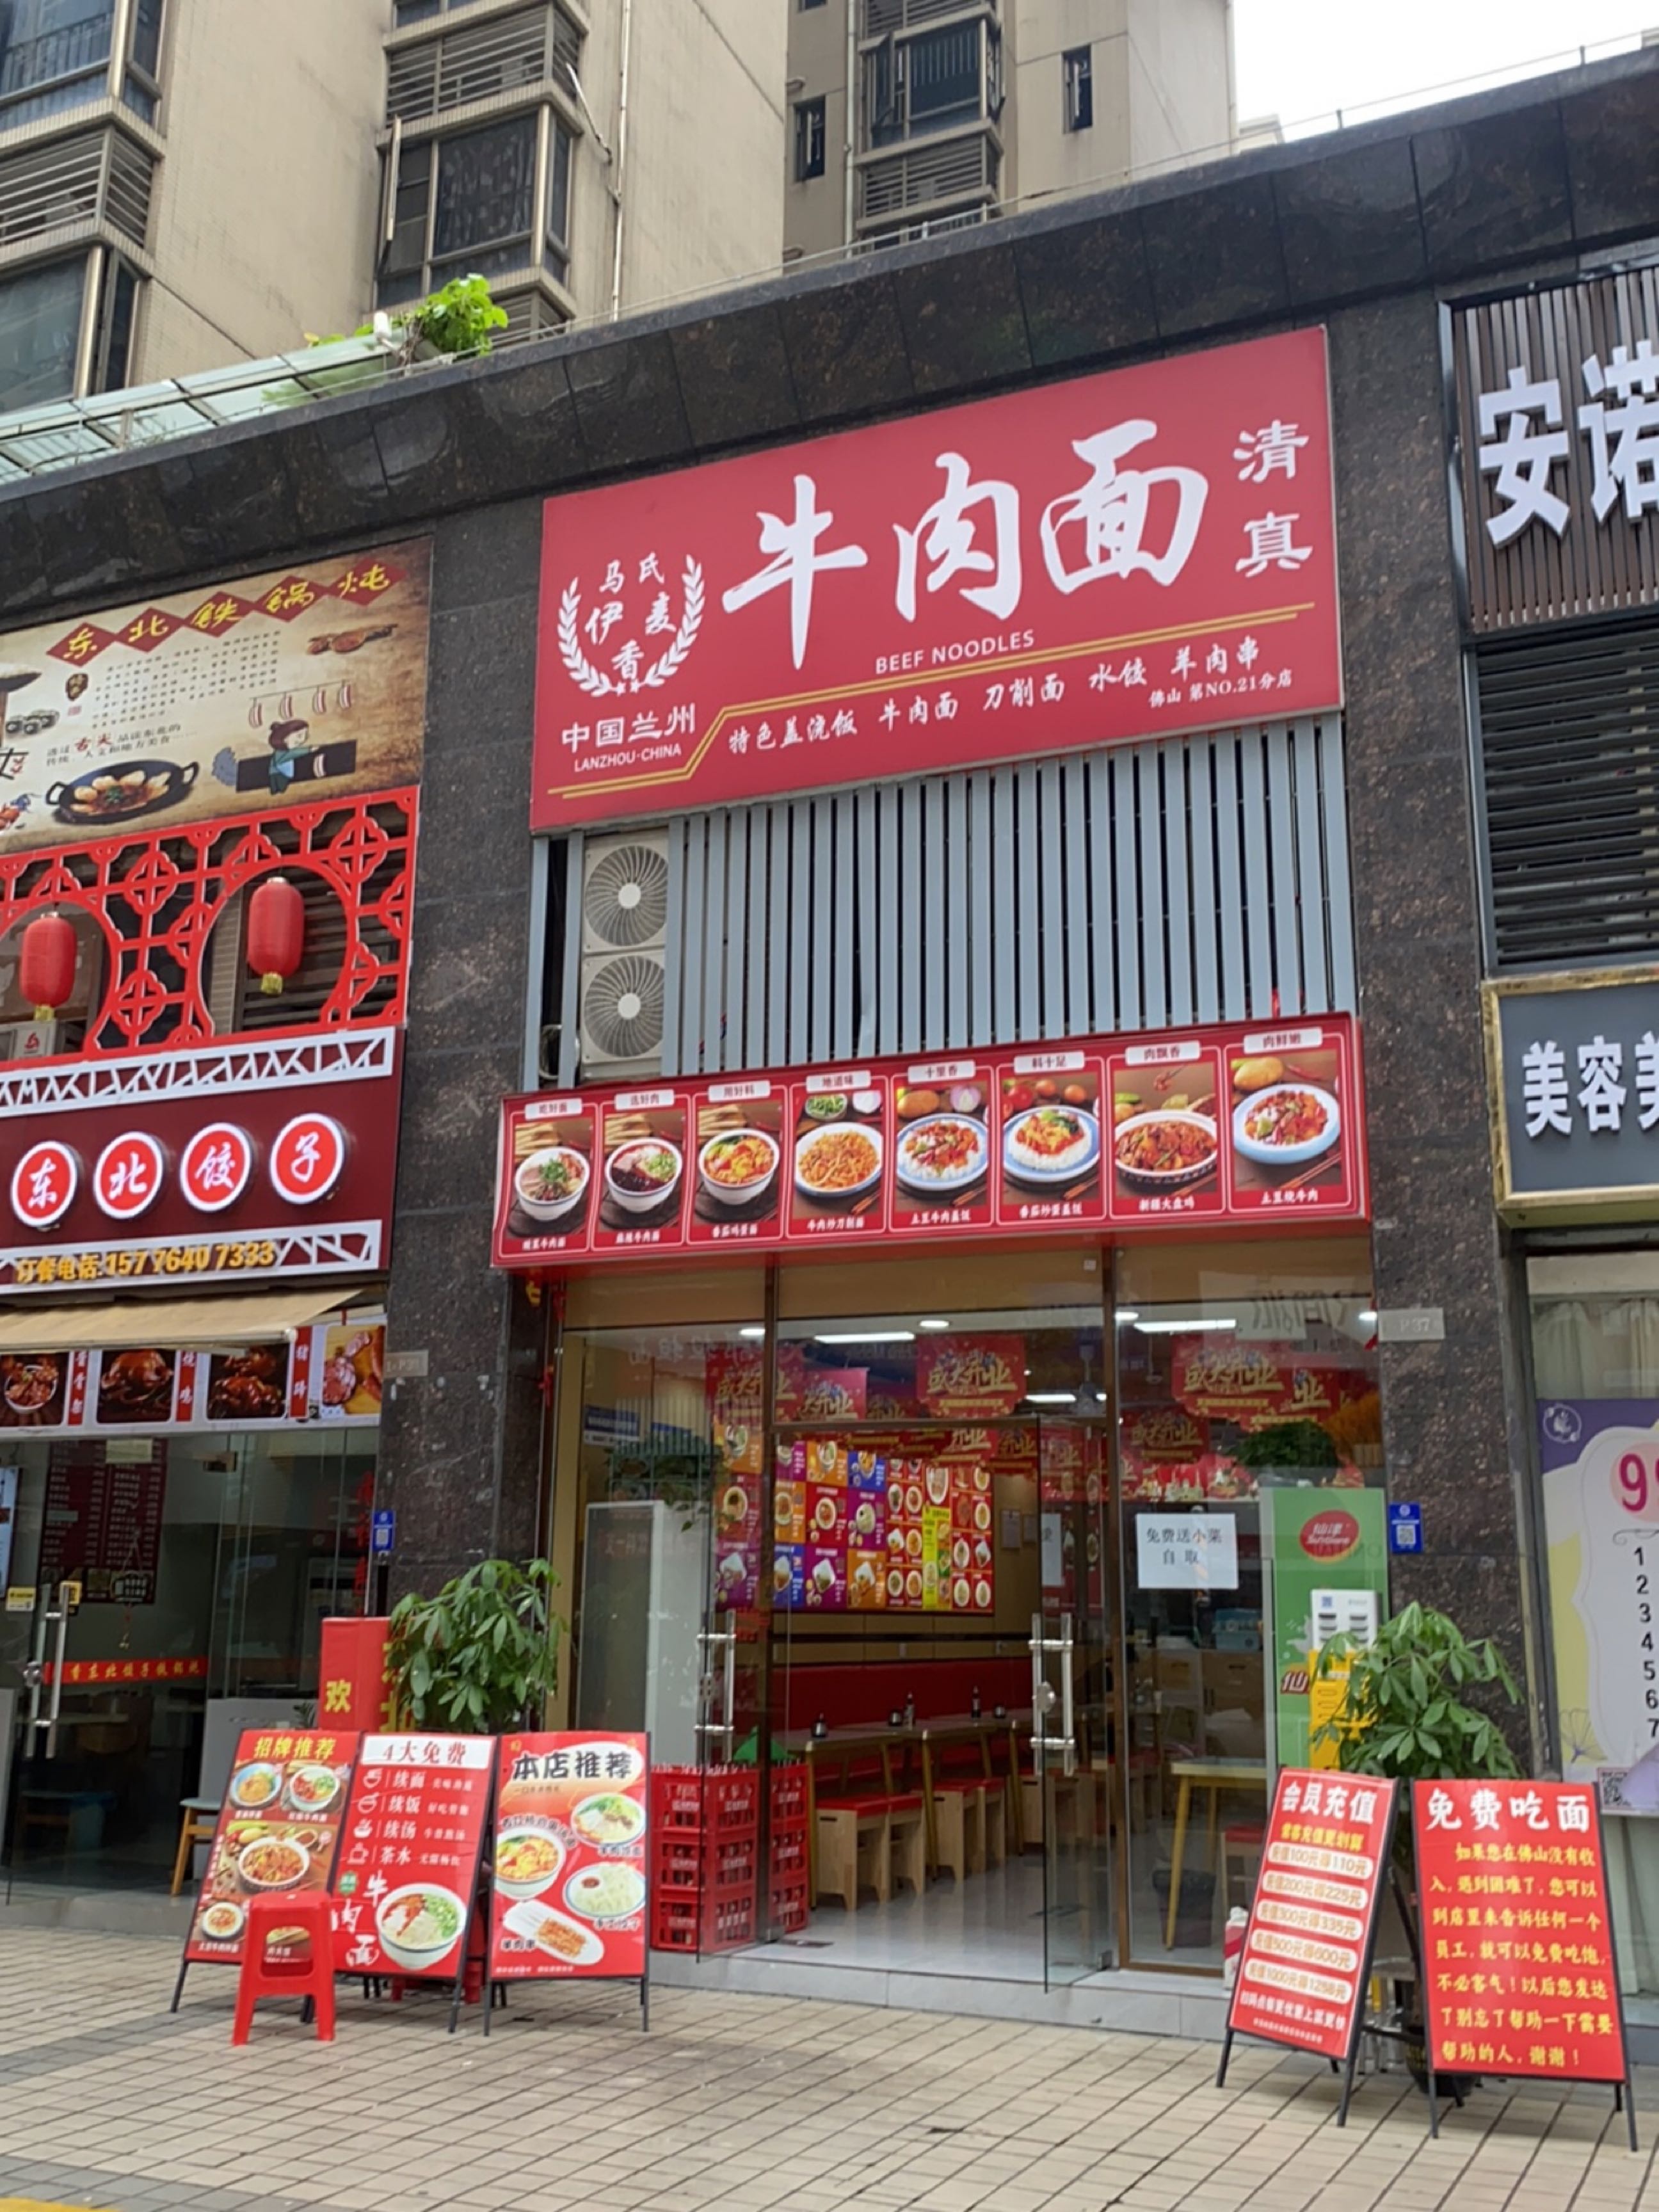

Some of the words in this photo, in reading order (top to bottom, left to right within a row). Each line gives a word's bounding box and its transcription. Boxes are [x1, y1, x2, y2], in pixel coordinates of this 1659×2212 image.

[1233, 419, 1313, 578] 清真
[723, 419, 1209, 670] 牛肉面
[599, 552, 665, 594] 马氏
[876, 649, 925, 674] BEEF
[932, 630, 1035, 664] NOODLES
[728, 710, 858, 754] 特色盖浇饭
[878, 696, 959, 732] 牛肉面
[982, 673, 1066, 711] 刀削面
[1089, 657, 1148, 693] 水饺
[1170, 635, 1261, 680] 羊肉串
[1150, 687, 1182, 709] 佛山
[561, 703, 696, 753] 中国兰州
[28, 1132, 321, 1209] 东北饺子
[153, 1245, 210, 1274] 7640
[216, 1240, 276, 1268] 7333
[1634, 1547, 1644, 1567] 1
[1636, 1575, 1649, 1594] 2
[1639, 1602, 1651, 1623] 3
[1640, 1632, 1655, 1652] 4
[1643, 1660, 1656, 1680] 5
[325, 1679, 352, 1713] 欢
[1646, 1688, 1659, 1709] 6
[253, 1735, 337, 1760] 招牌推荐
[383, 1740, 467, 1766] 4大免费
[392, 1769, 426, 1788] 续面
[513, 1750, 632, 1780] 本店推荐
[388, 1794, 421, 1815] 续饭
[1282, 1779, 1377, 1825] 会员充值
[1425, 1787, 1591, 1832] 免费吃面
[383, 1819, 417, 1840] 续汤
[1455, 1841, 1596, 1868] 如果您在佛山没有收
[1432, 1907, 1601, 1932] 到店里来告诉任何一个
[1441, 2007, 1614, 2036] 了别忘了帮助一下需要
